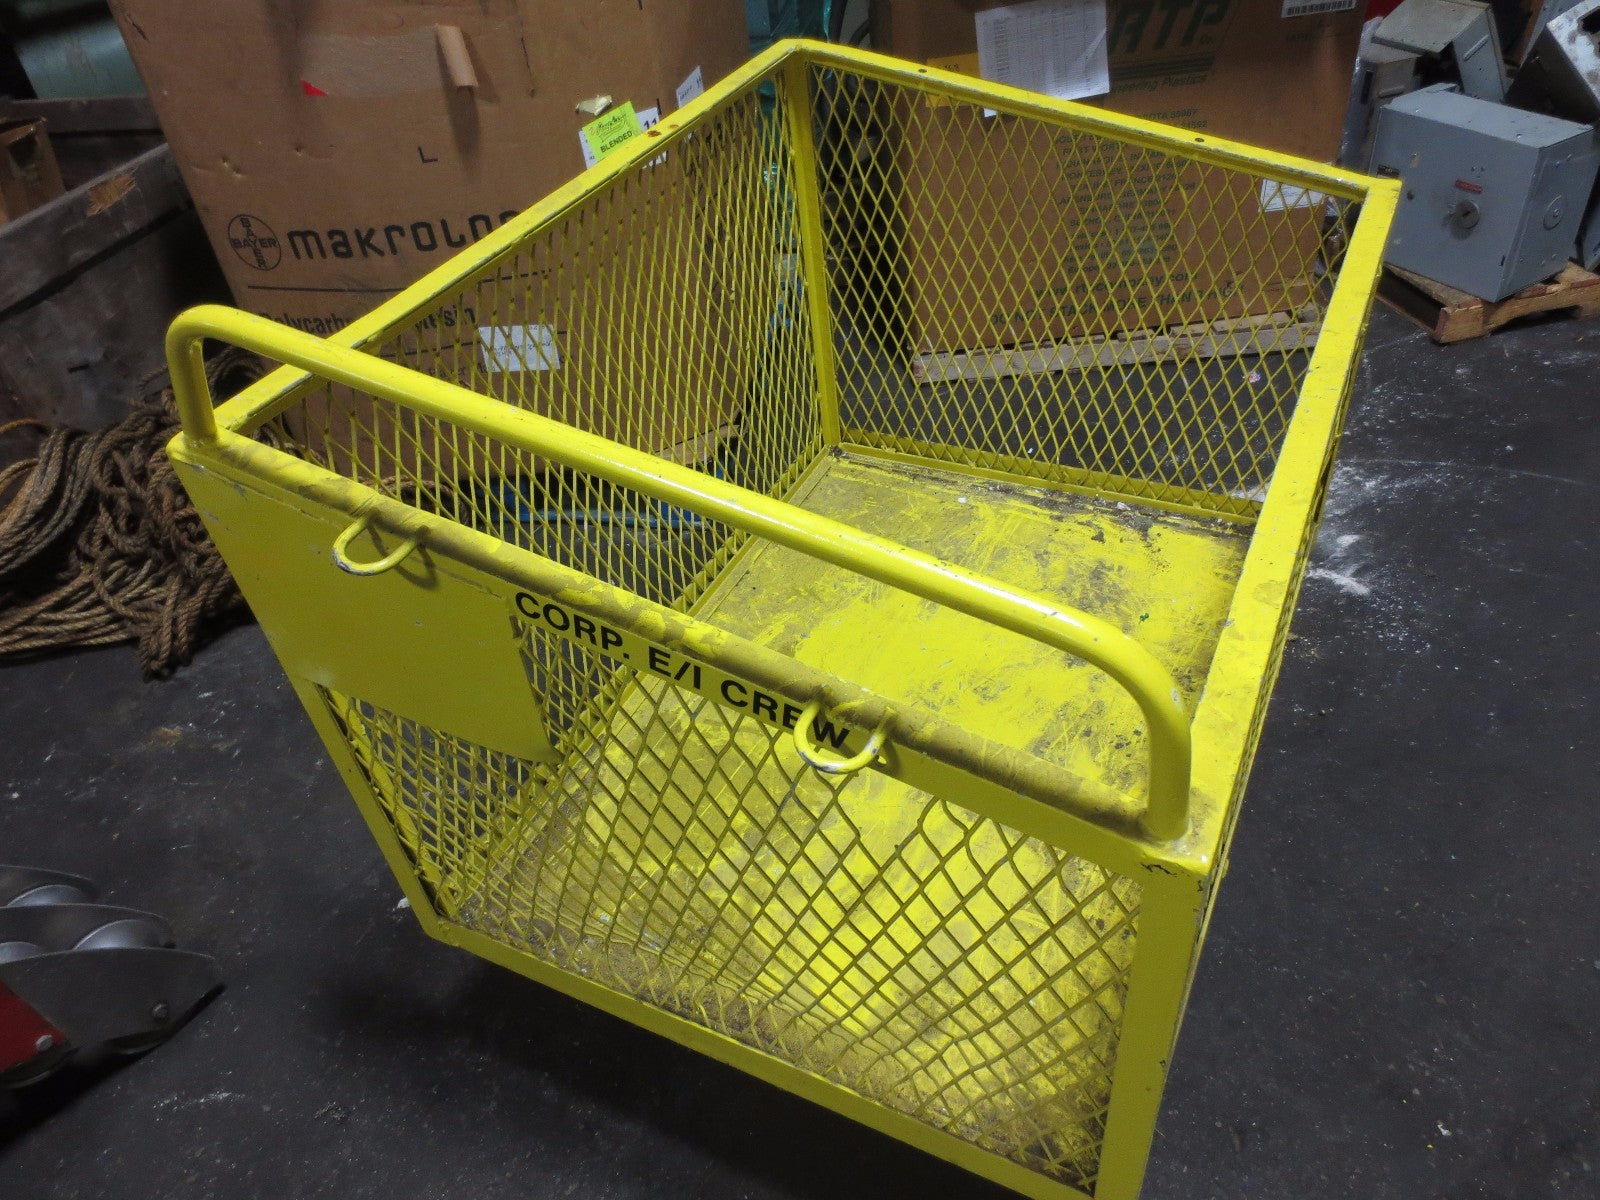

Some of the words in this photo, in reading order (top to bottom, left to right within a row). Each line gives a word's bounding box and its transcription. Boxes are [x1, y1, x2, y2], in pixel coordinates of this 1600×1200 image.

[600, 130, 632, 153] BLENDED
[231, 238, 277, 248] BAYER
[515, 591, 631, 660] CORP.
[720, 679, 851, 750] CREW
